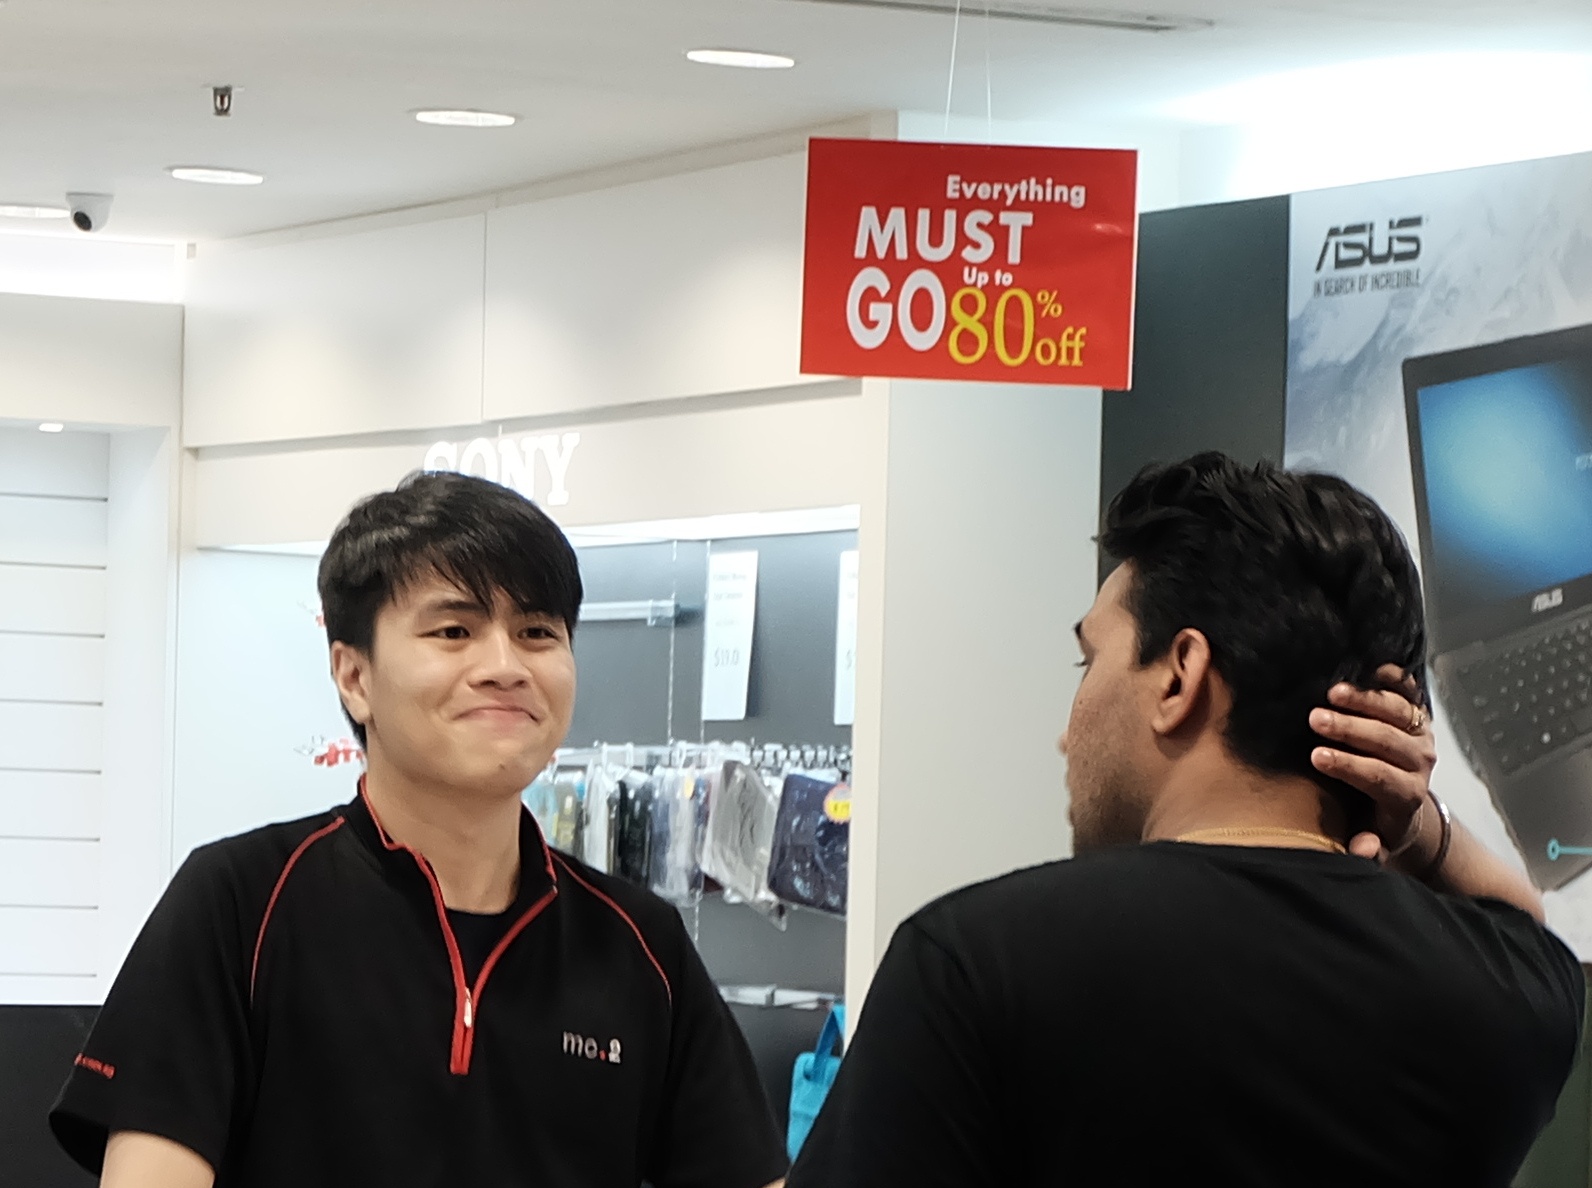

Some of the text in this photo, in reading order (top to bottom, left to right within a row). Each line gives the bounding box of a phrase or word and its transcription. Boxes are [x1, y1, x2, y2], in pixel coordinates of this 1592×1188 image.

[946, 174, 1086, 208] Everything
[854, 206, 1034, 265] MUST
[1315, 214, 1423, 273] ASUS
[963, 266, 1014, 288] Up to
[1324, 276, 1355, 297] SEARCH
[1370, 268, 1421, 292] INCREDIBLE
[846, 266, 947, 352] GO
[1034, 327, 1087, 366] off
